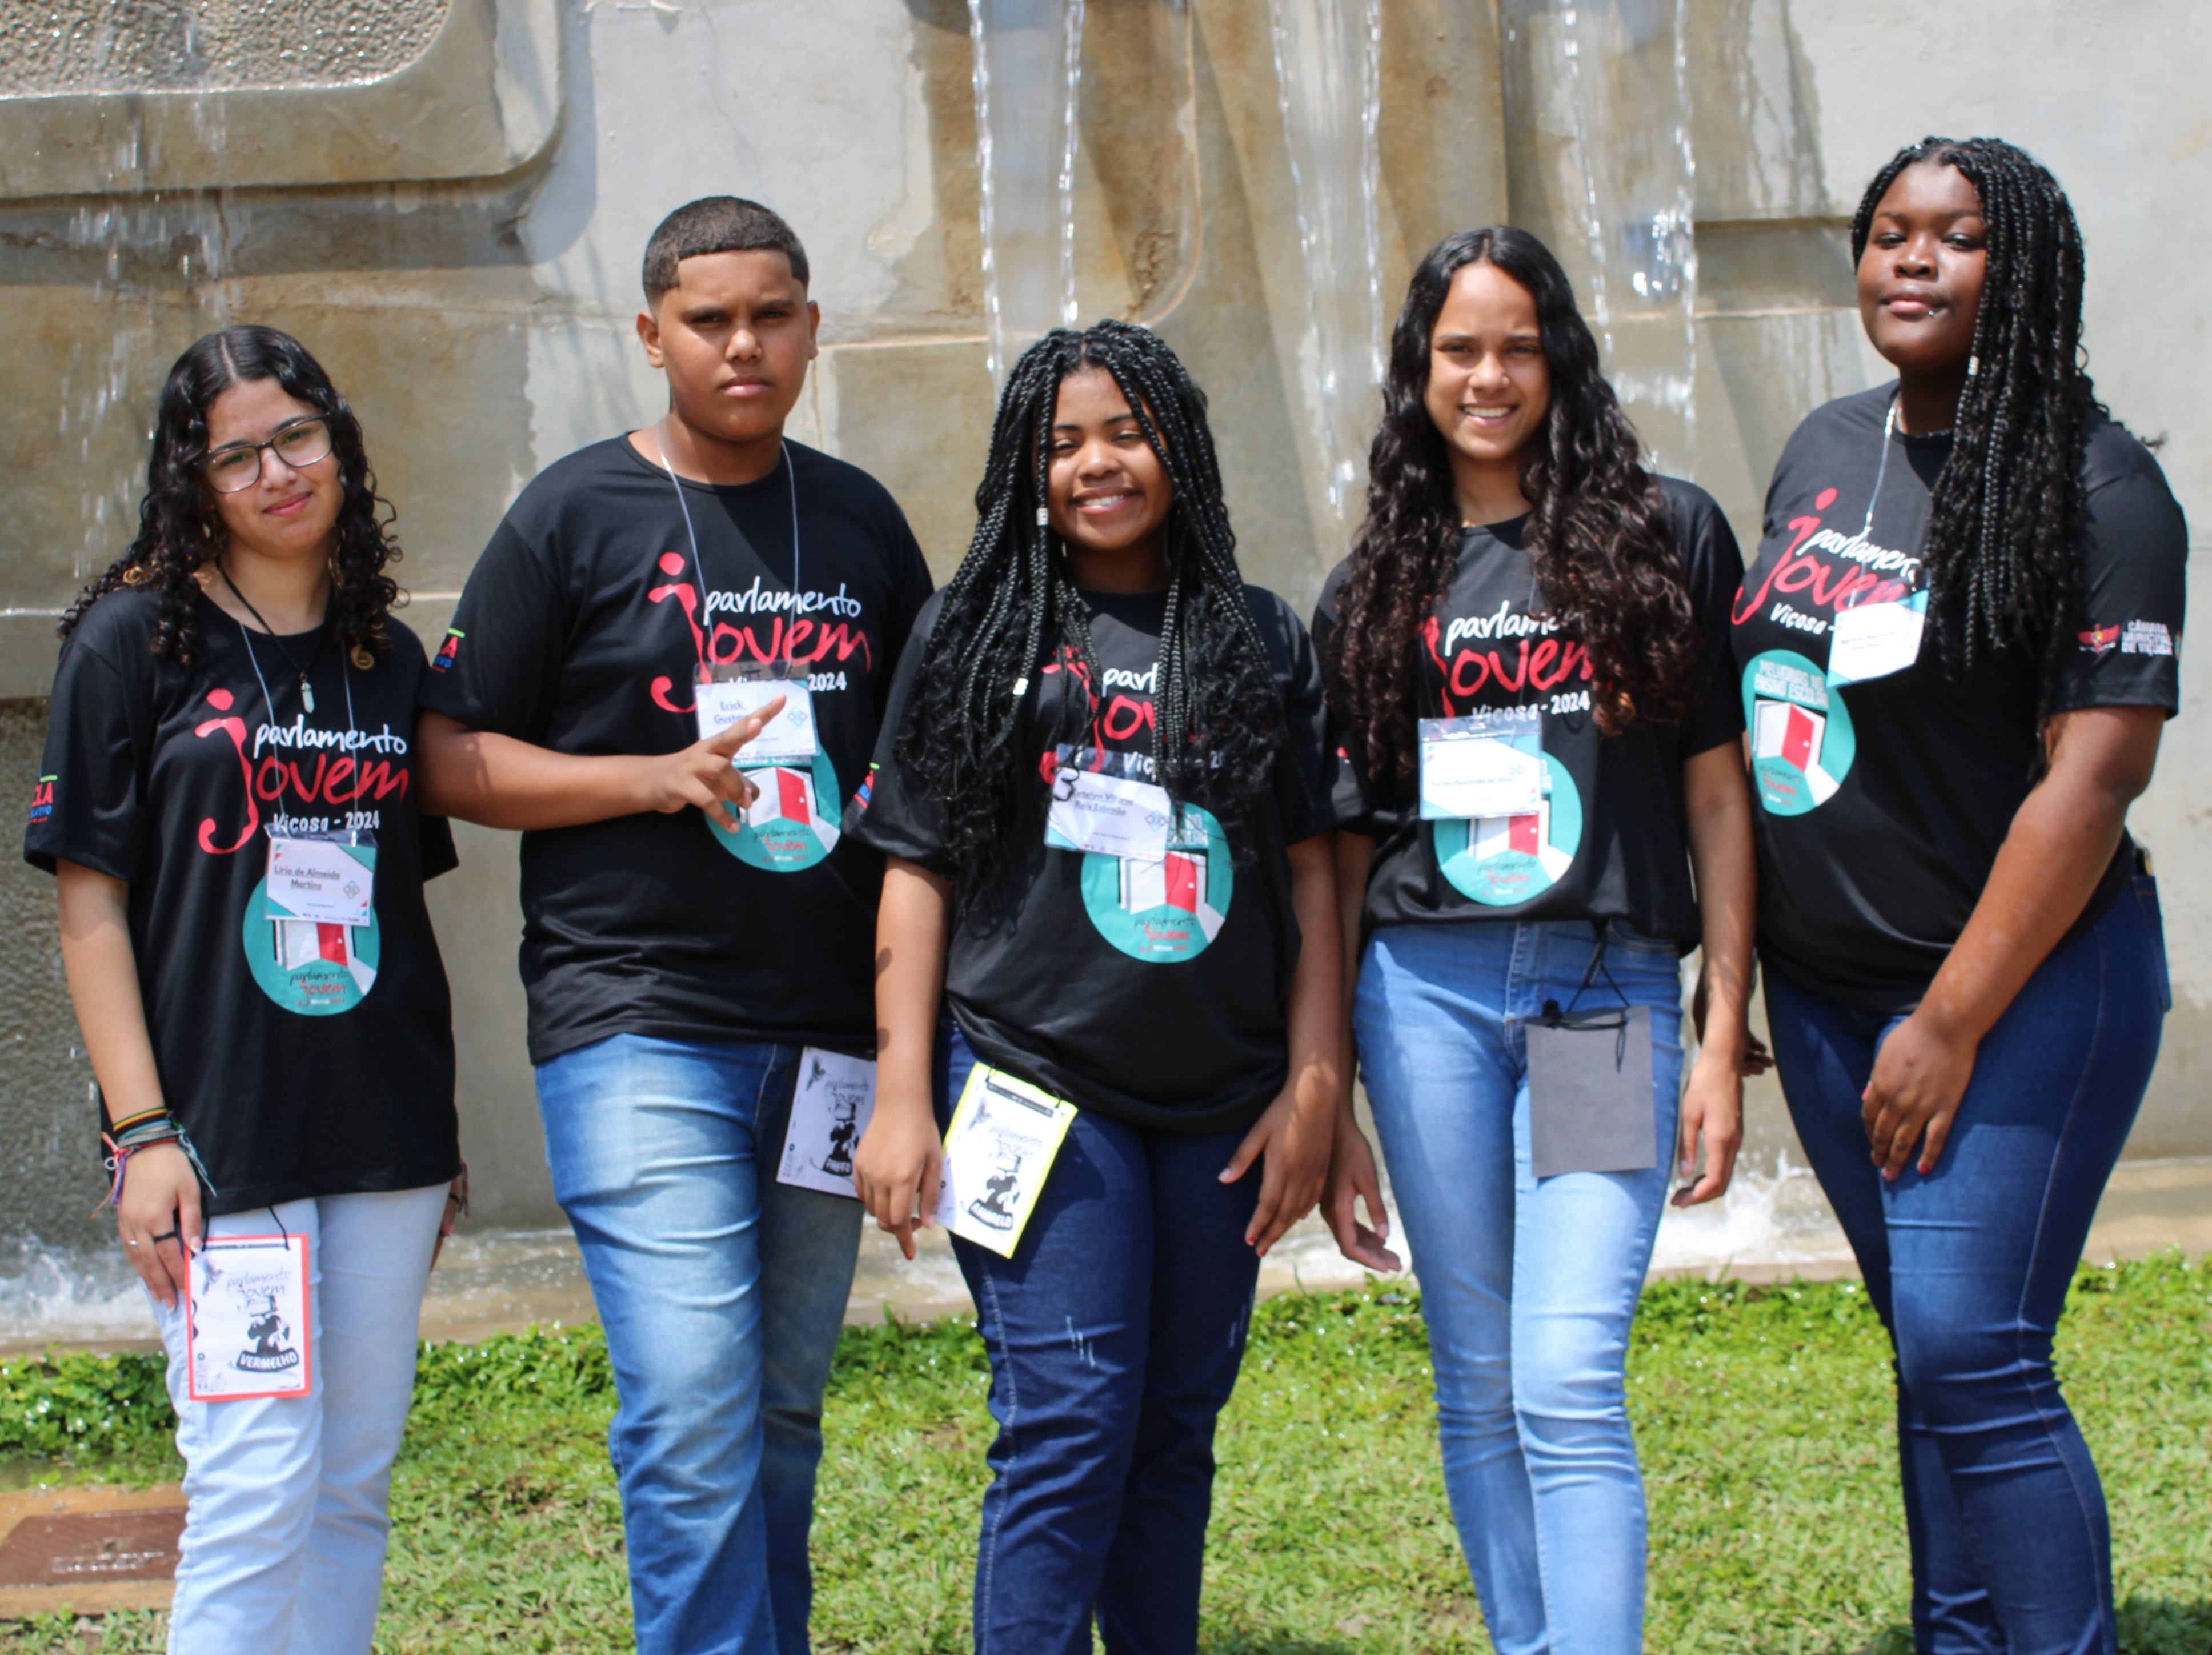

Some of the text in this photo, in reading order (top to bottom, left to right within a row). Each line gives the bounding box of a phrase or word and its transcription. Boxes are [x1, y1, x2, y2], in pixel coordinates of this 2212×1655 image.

[703, 575, 861, 627] parlamento
[648, 552, 872, 713] jovem
[1770, 602, 1828, 635] Viçosa
[2121, 641, 2137, 653] DE
[807, 671, 847, 692] 2024
[1472, 704, 1539, 724] Viçosa
[1550, 690, 1591, 715] 2024
[253, 714, 407, 759] parlamento
[194, 688, 409, 855] jovem
[345, 810, 380, 829] 2024
[297, 979, 345, 1008] jovem
[227, 1265, 290, 1292] parlamento
[239, 1349, 298, 1369] VERMELHO
